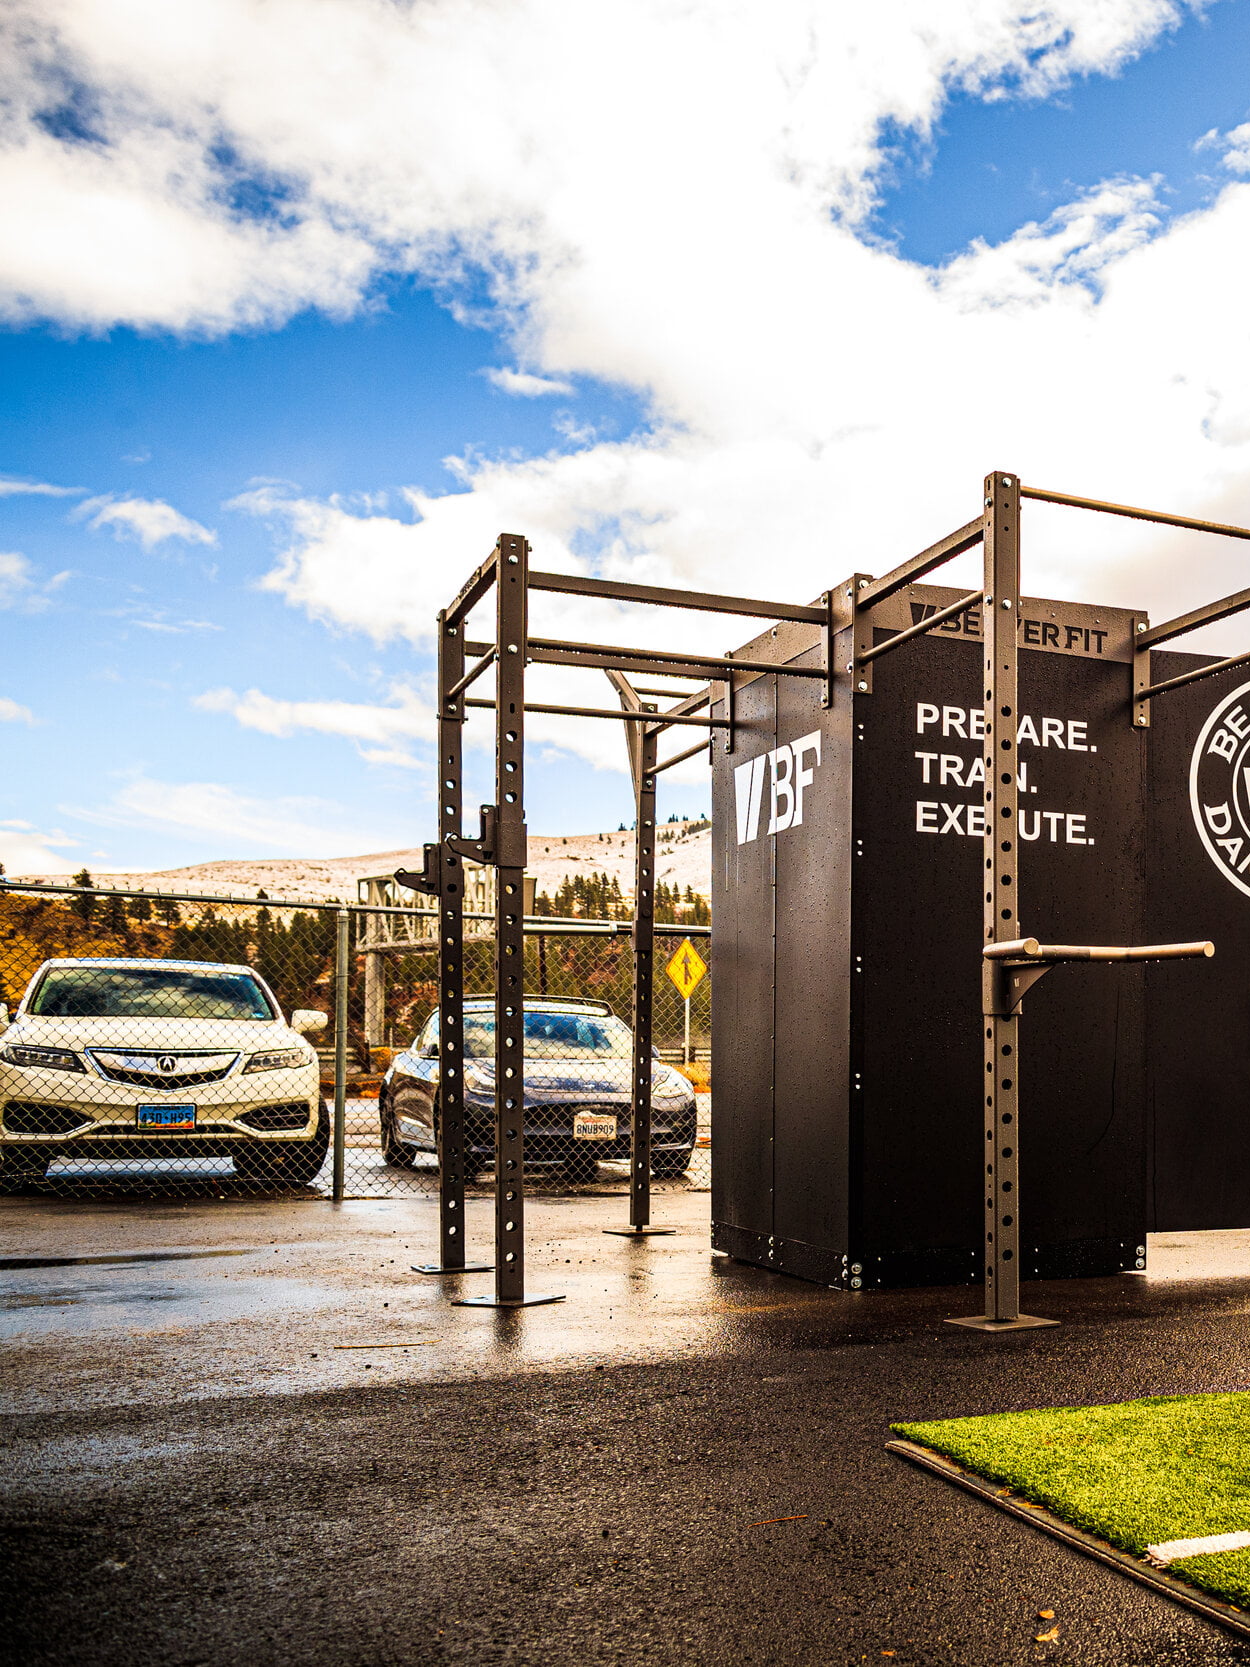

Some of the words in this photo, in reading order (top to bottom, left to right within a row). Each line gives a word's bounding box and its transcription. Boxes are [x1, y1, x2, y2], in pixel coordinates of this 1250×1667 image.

[916, 702, 1098, 753] PREARE.
[914, 751, 1038, 794] TRA.
[915, 800, 1096, 846] EXEUTE.
